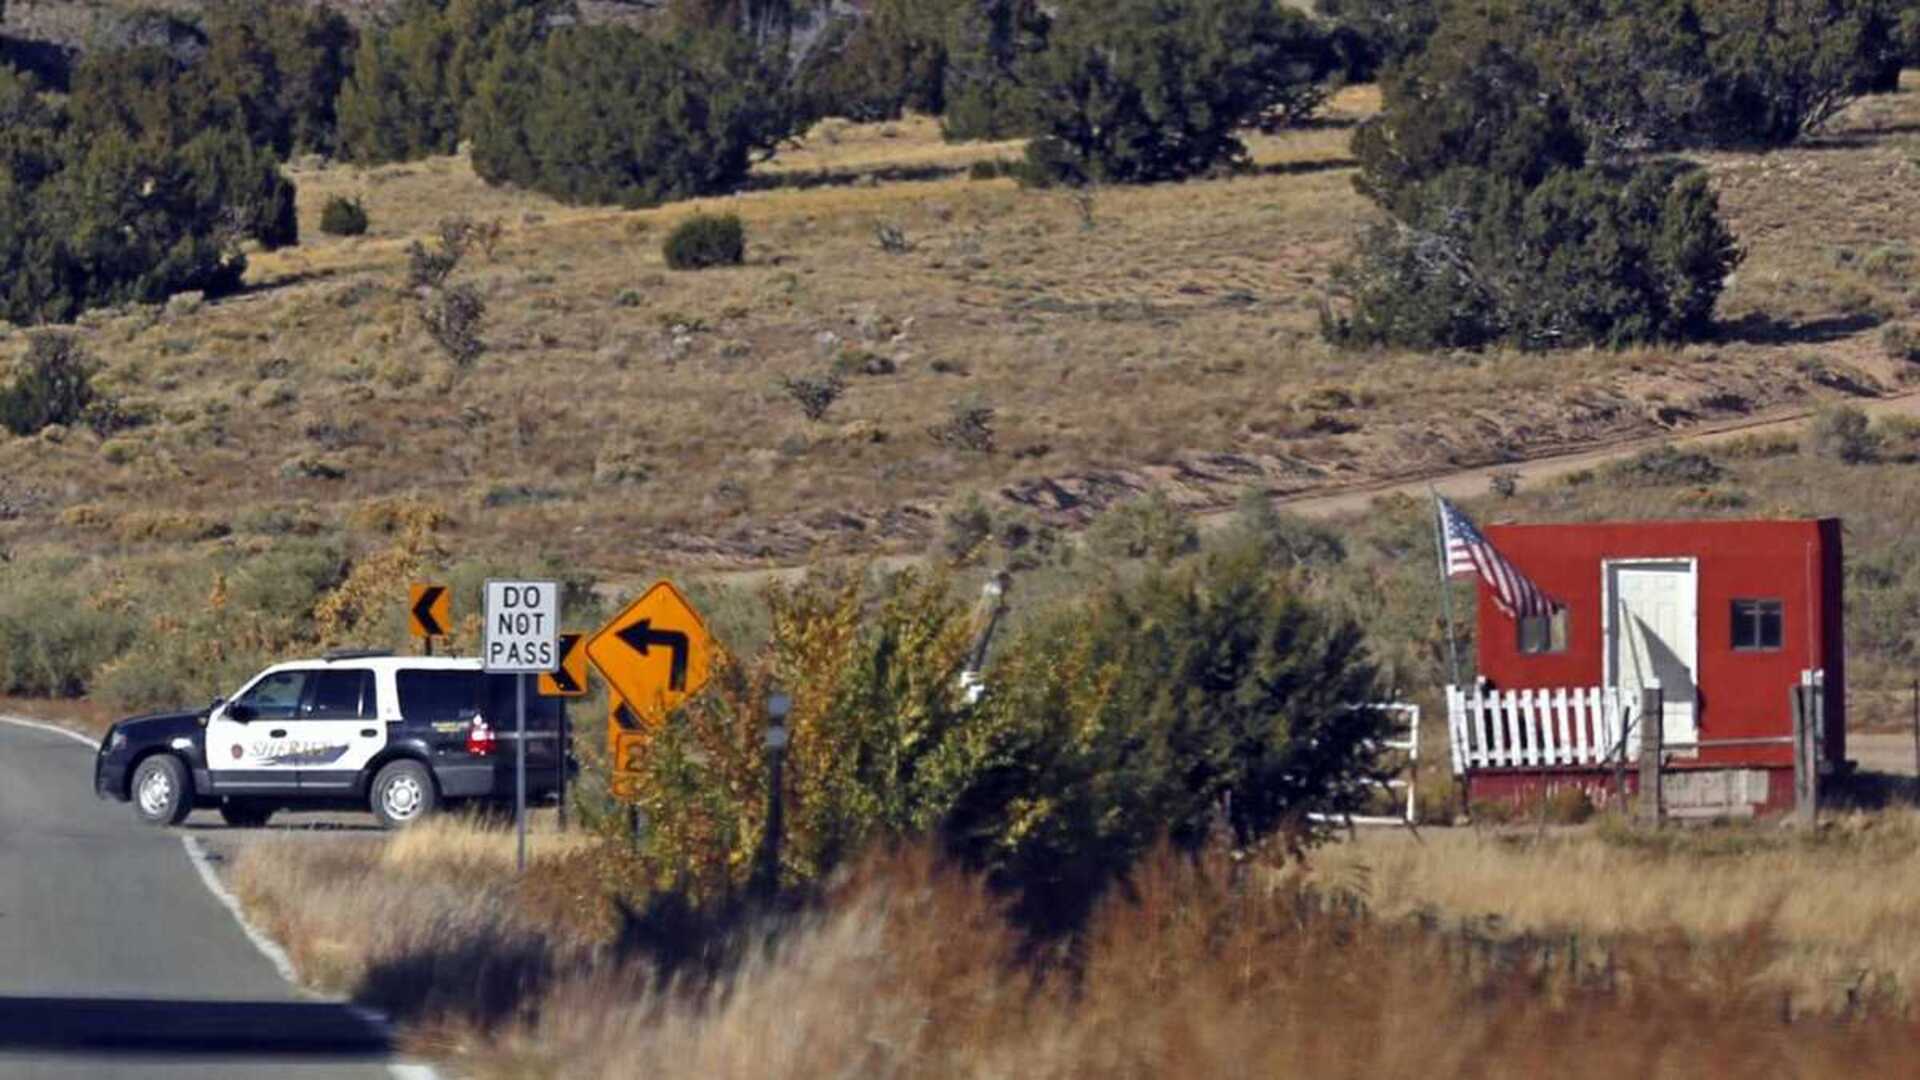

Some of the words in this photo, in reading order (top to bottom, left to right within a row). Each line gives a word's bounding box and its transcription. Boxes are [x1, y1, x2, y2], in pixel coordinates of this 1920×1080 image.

[503, 586, 541, 609] DO
[498, 612, 545, 636] NOT
[490, 641, 552, 665] PASS
